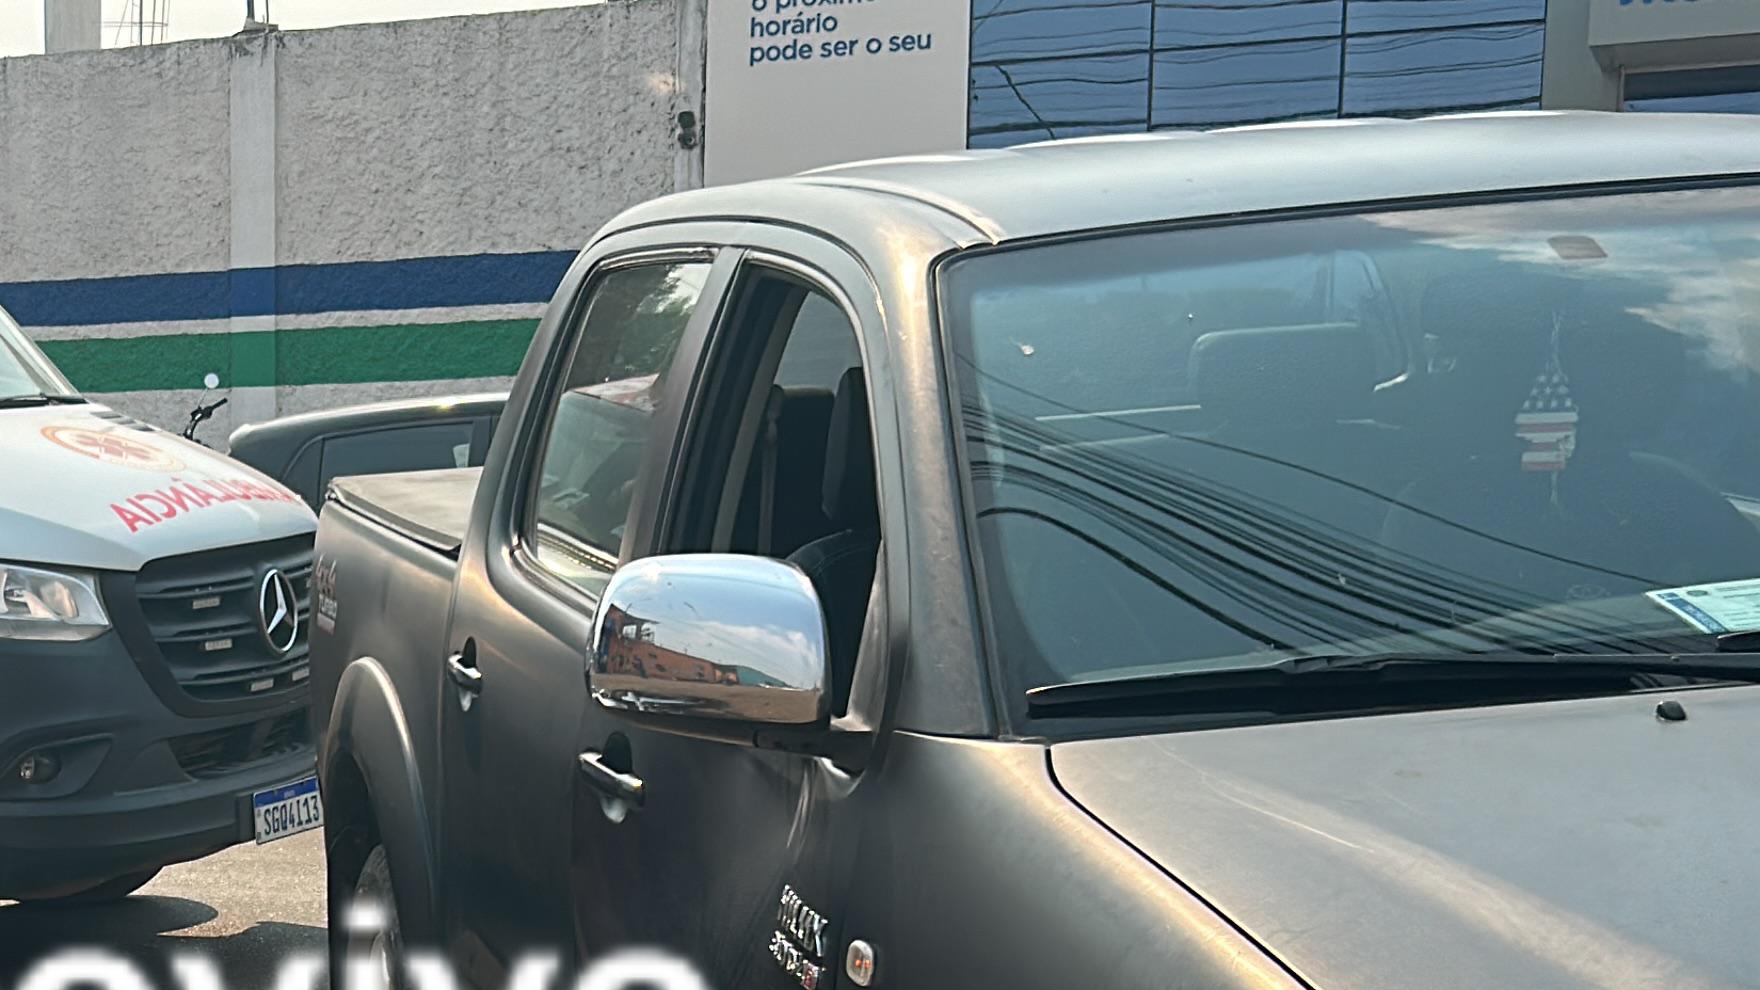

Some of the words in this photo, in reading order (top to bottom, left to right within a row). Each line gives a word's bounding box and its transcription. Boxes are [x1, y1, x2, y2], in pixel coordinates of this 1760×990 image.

[749, 12, 838, 37] horário
[749, 39, 812, 66] pode
[820, 40, 858, 58] ser
[866, 37, 882, 54] o
[889, 33, 932, 51] seu
